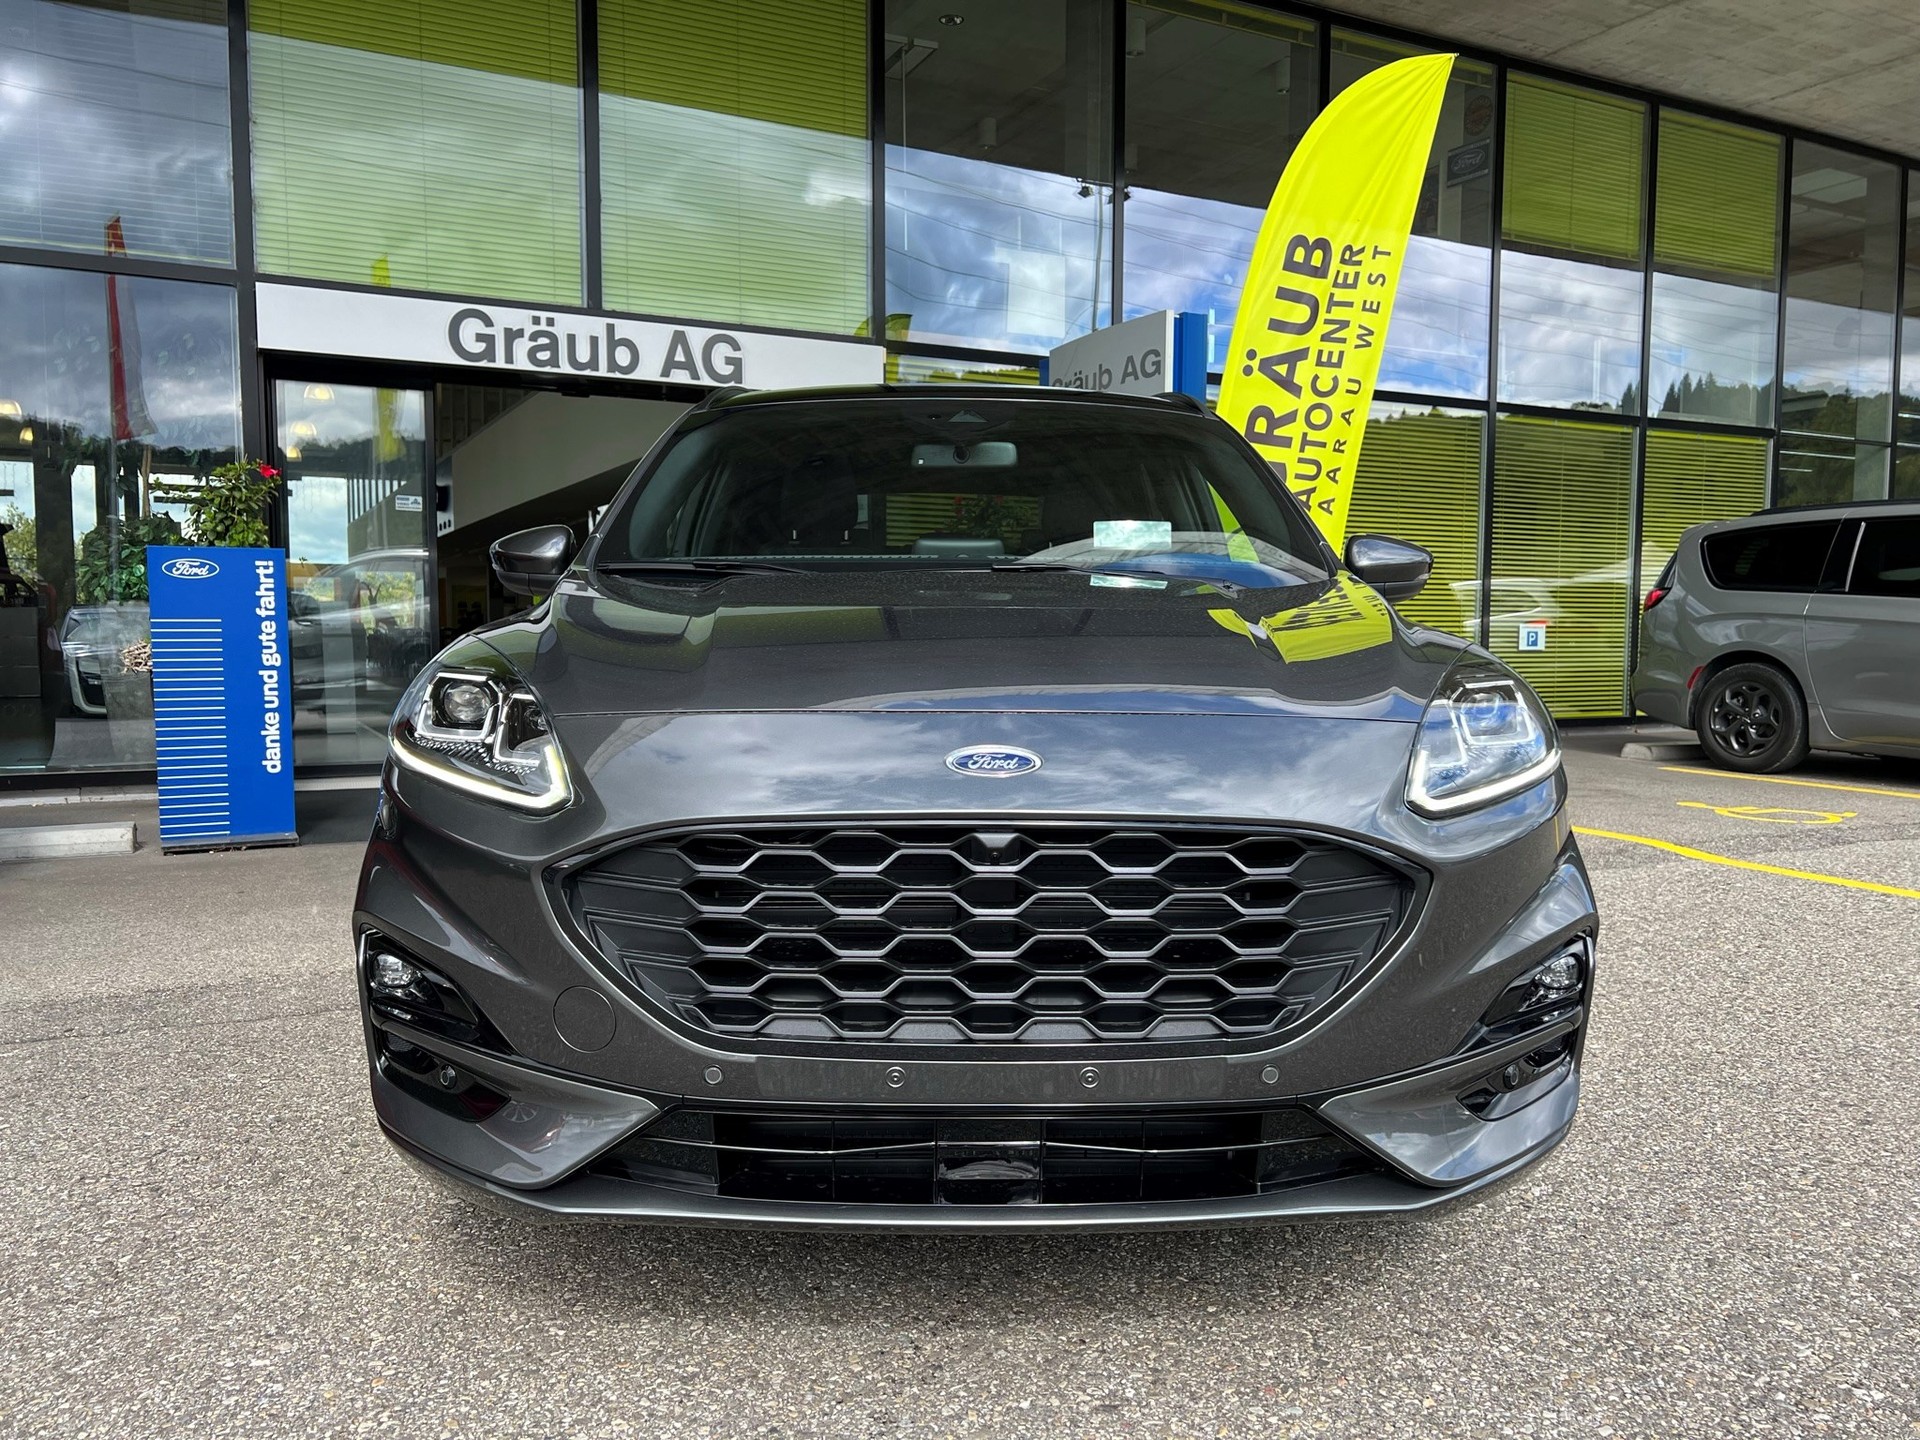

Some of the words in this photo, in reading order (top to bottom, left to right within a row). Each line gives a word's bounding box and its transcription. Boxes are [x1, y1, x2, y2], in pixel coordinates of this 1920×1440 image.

[448, 308, 640, 375] Gräub
[660, 329, 743, 384] AG
[1120, 349, 1162, 384] AG
[1243, 234, 1333, 484] RÄUB
[1293, 244, 1366, 512] AUTOCENTER
[1317, 378, 1362, 516] AARAU
[1353, 245, 1391, 349] WEST
[171, 560, 210, 576] Ford
[254, 560, 276, 618] fahrt!
[258, 620, 282, 667] gute
[258, 669, 279, 709] und
[260, 711, 282, 774] danke
